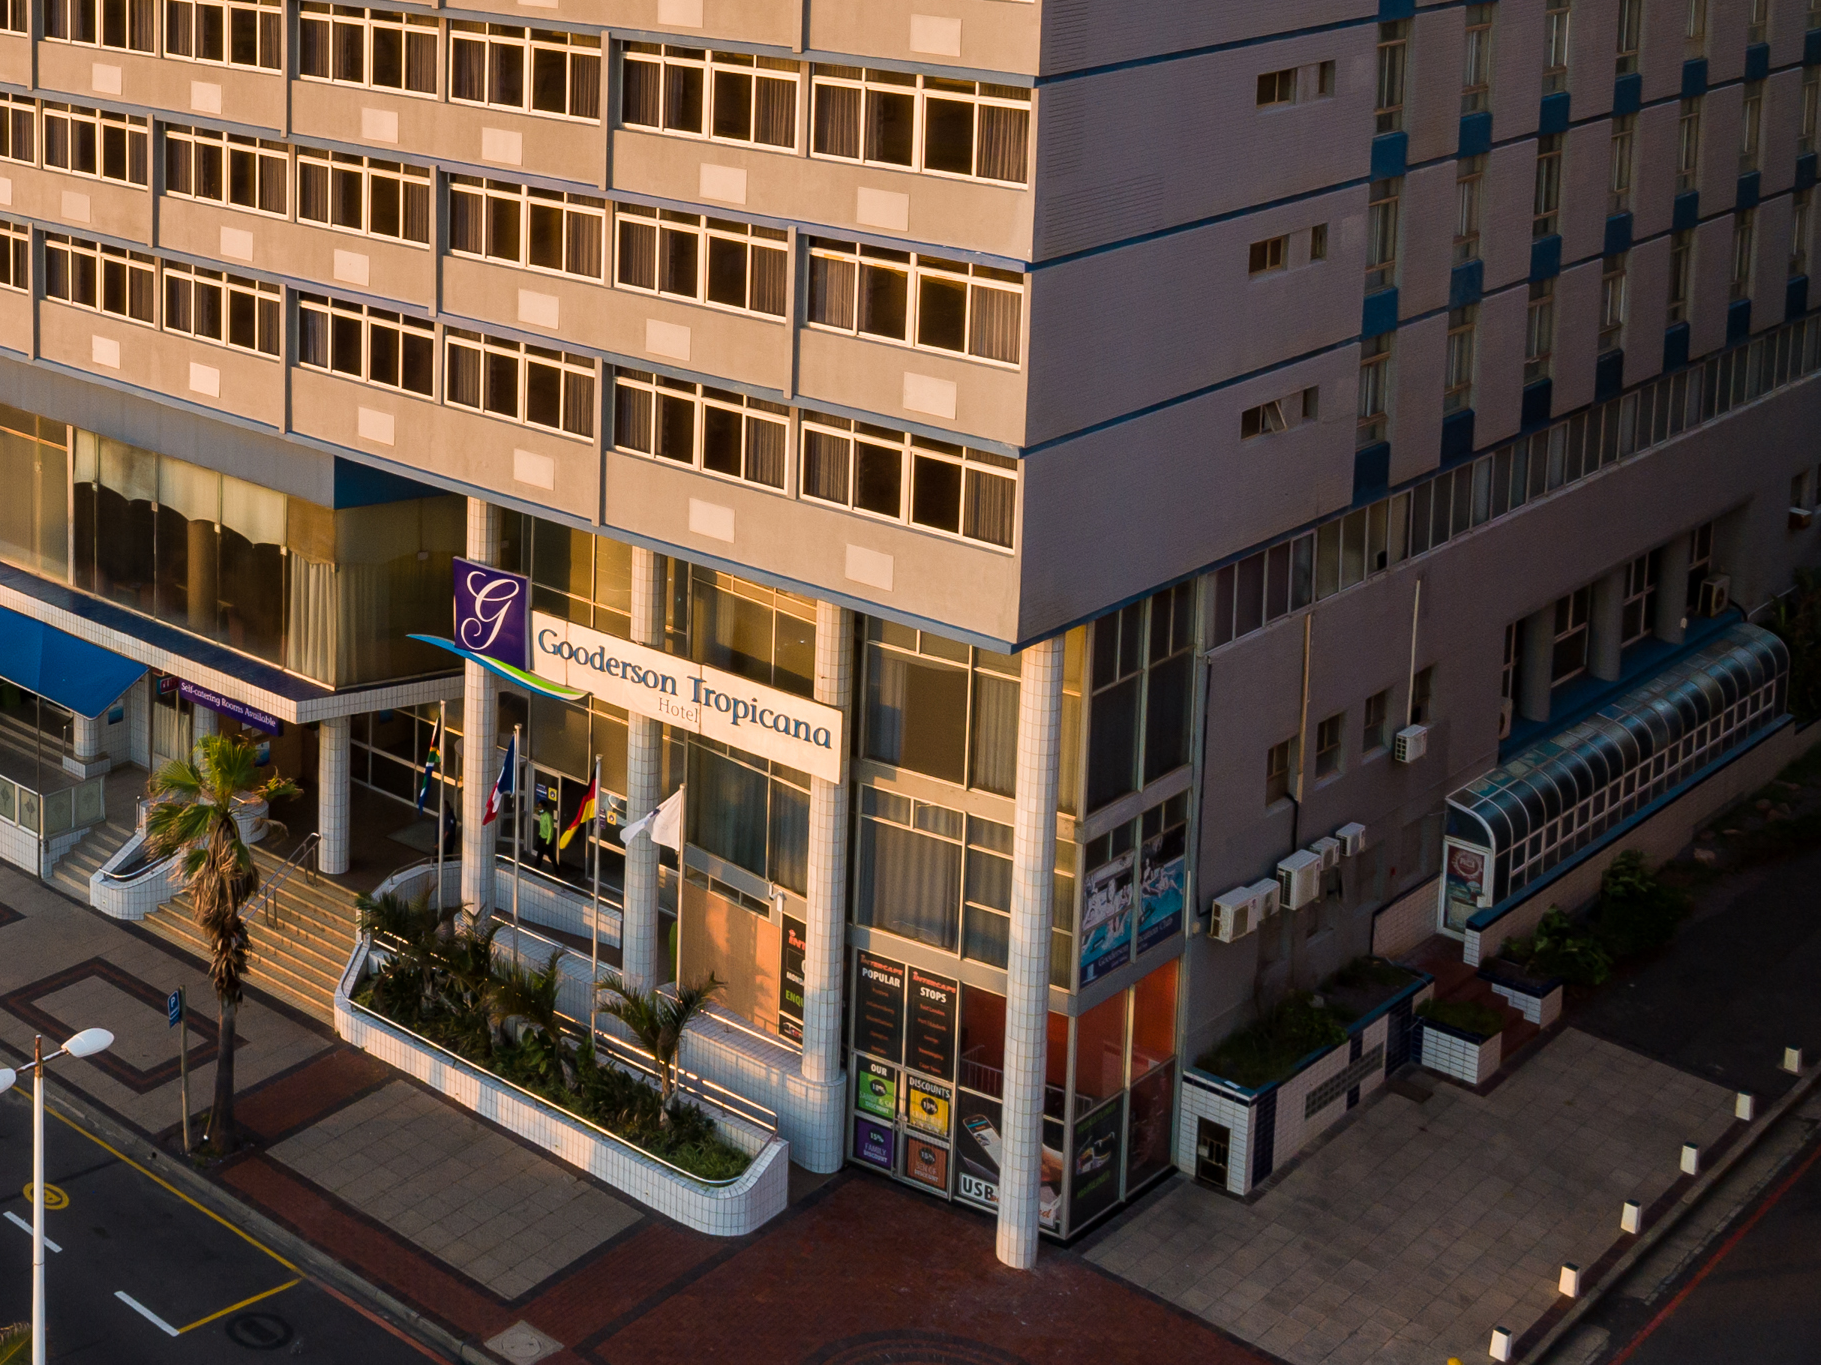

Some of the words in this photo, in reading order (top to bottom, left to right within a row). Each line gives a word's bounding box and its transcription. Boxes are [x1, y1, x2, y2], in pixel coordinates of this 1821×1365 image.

[538, 629, 677, 697] Gooderson
[687, 676, 831, 750] Tropicana
[181, 682, 221, 707] Self-catering
[221, 697, 244, 714] Rooms
[244, 707, 277, 727] Available
[658, 696, 699, 724] Hotel
[862, 967, 901, 988] POPULAR
[920, 986, 947, 1003] STOPS
[870, 1063, 888, 1077] OUR
[909, 1076, 951, 1099] DISCOUNTS
[963, 1176, 994, 1201] USB
